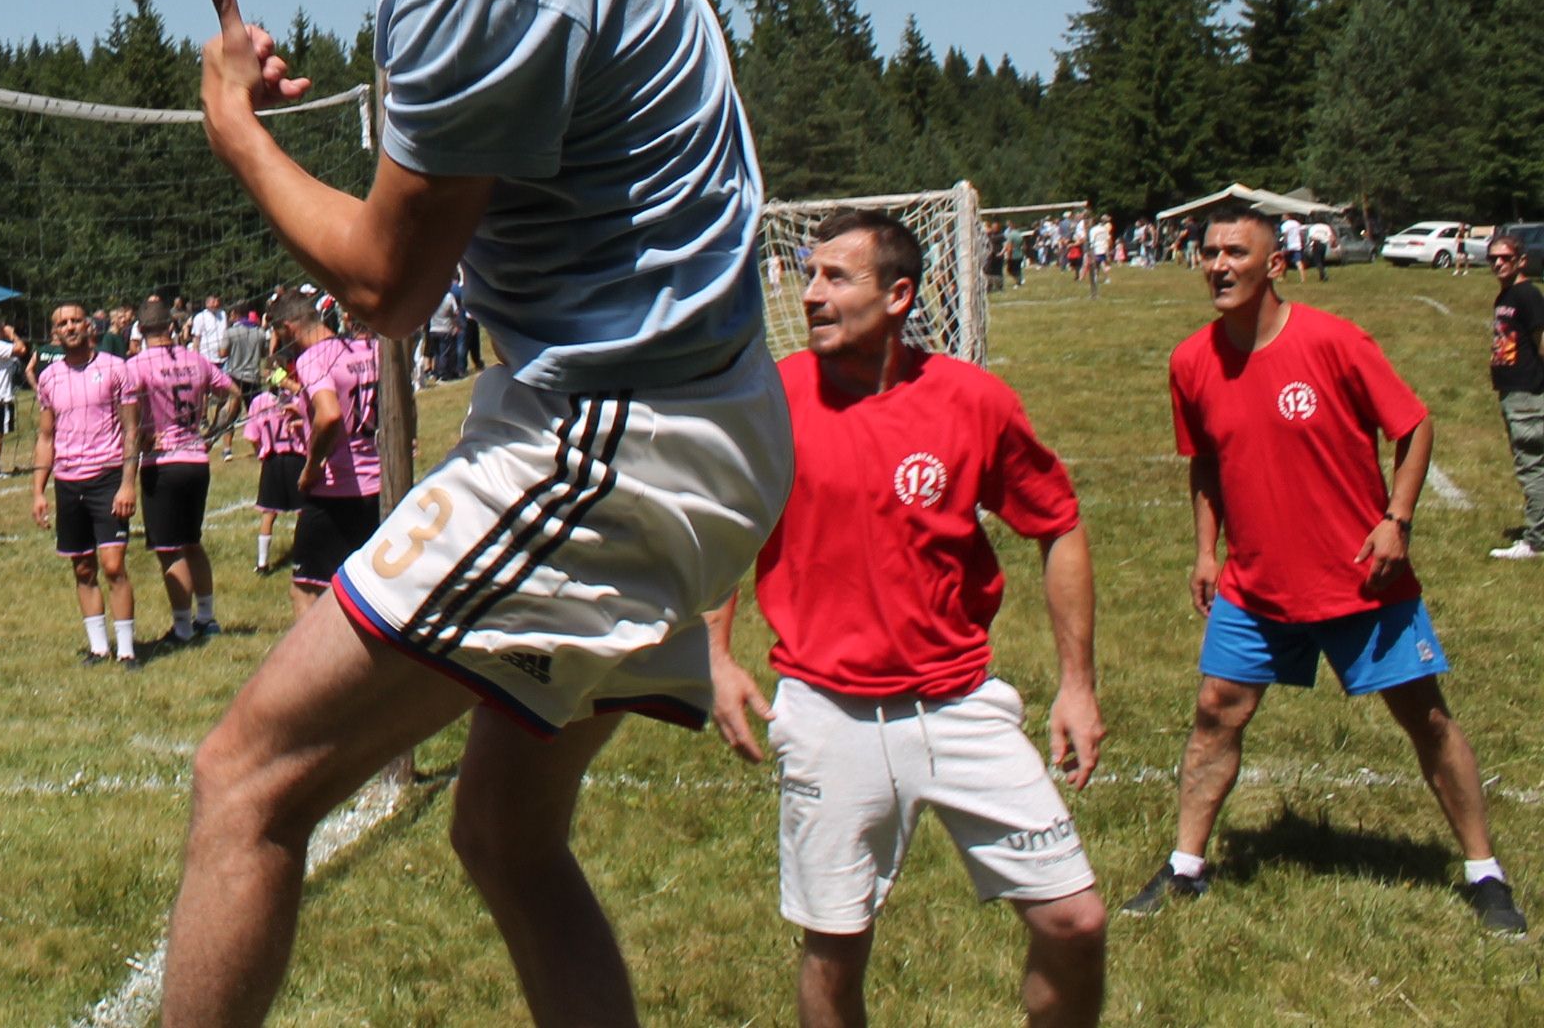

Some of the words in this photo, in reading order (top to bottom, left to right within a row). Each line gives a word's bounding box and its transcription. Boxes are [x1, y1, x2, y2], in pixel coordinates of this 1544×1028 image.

[1285, 390, 1310, 413] 12
[905, 464, 938, 497] 12
[371, 487, 453, 579] 3
[500, 653, 552, 685] adidas
